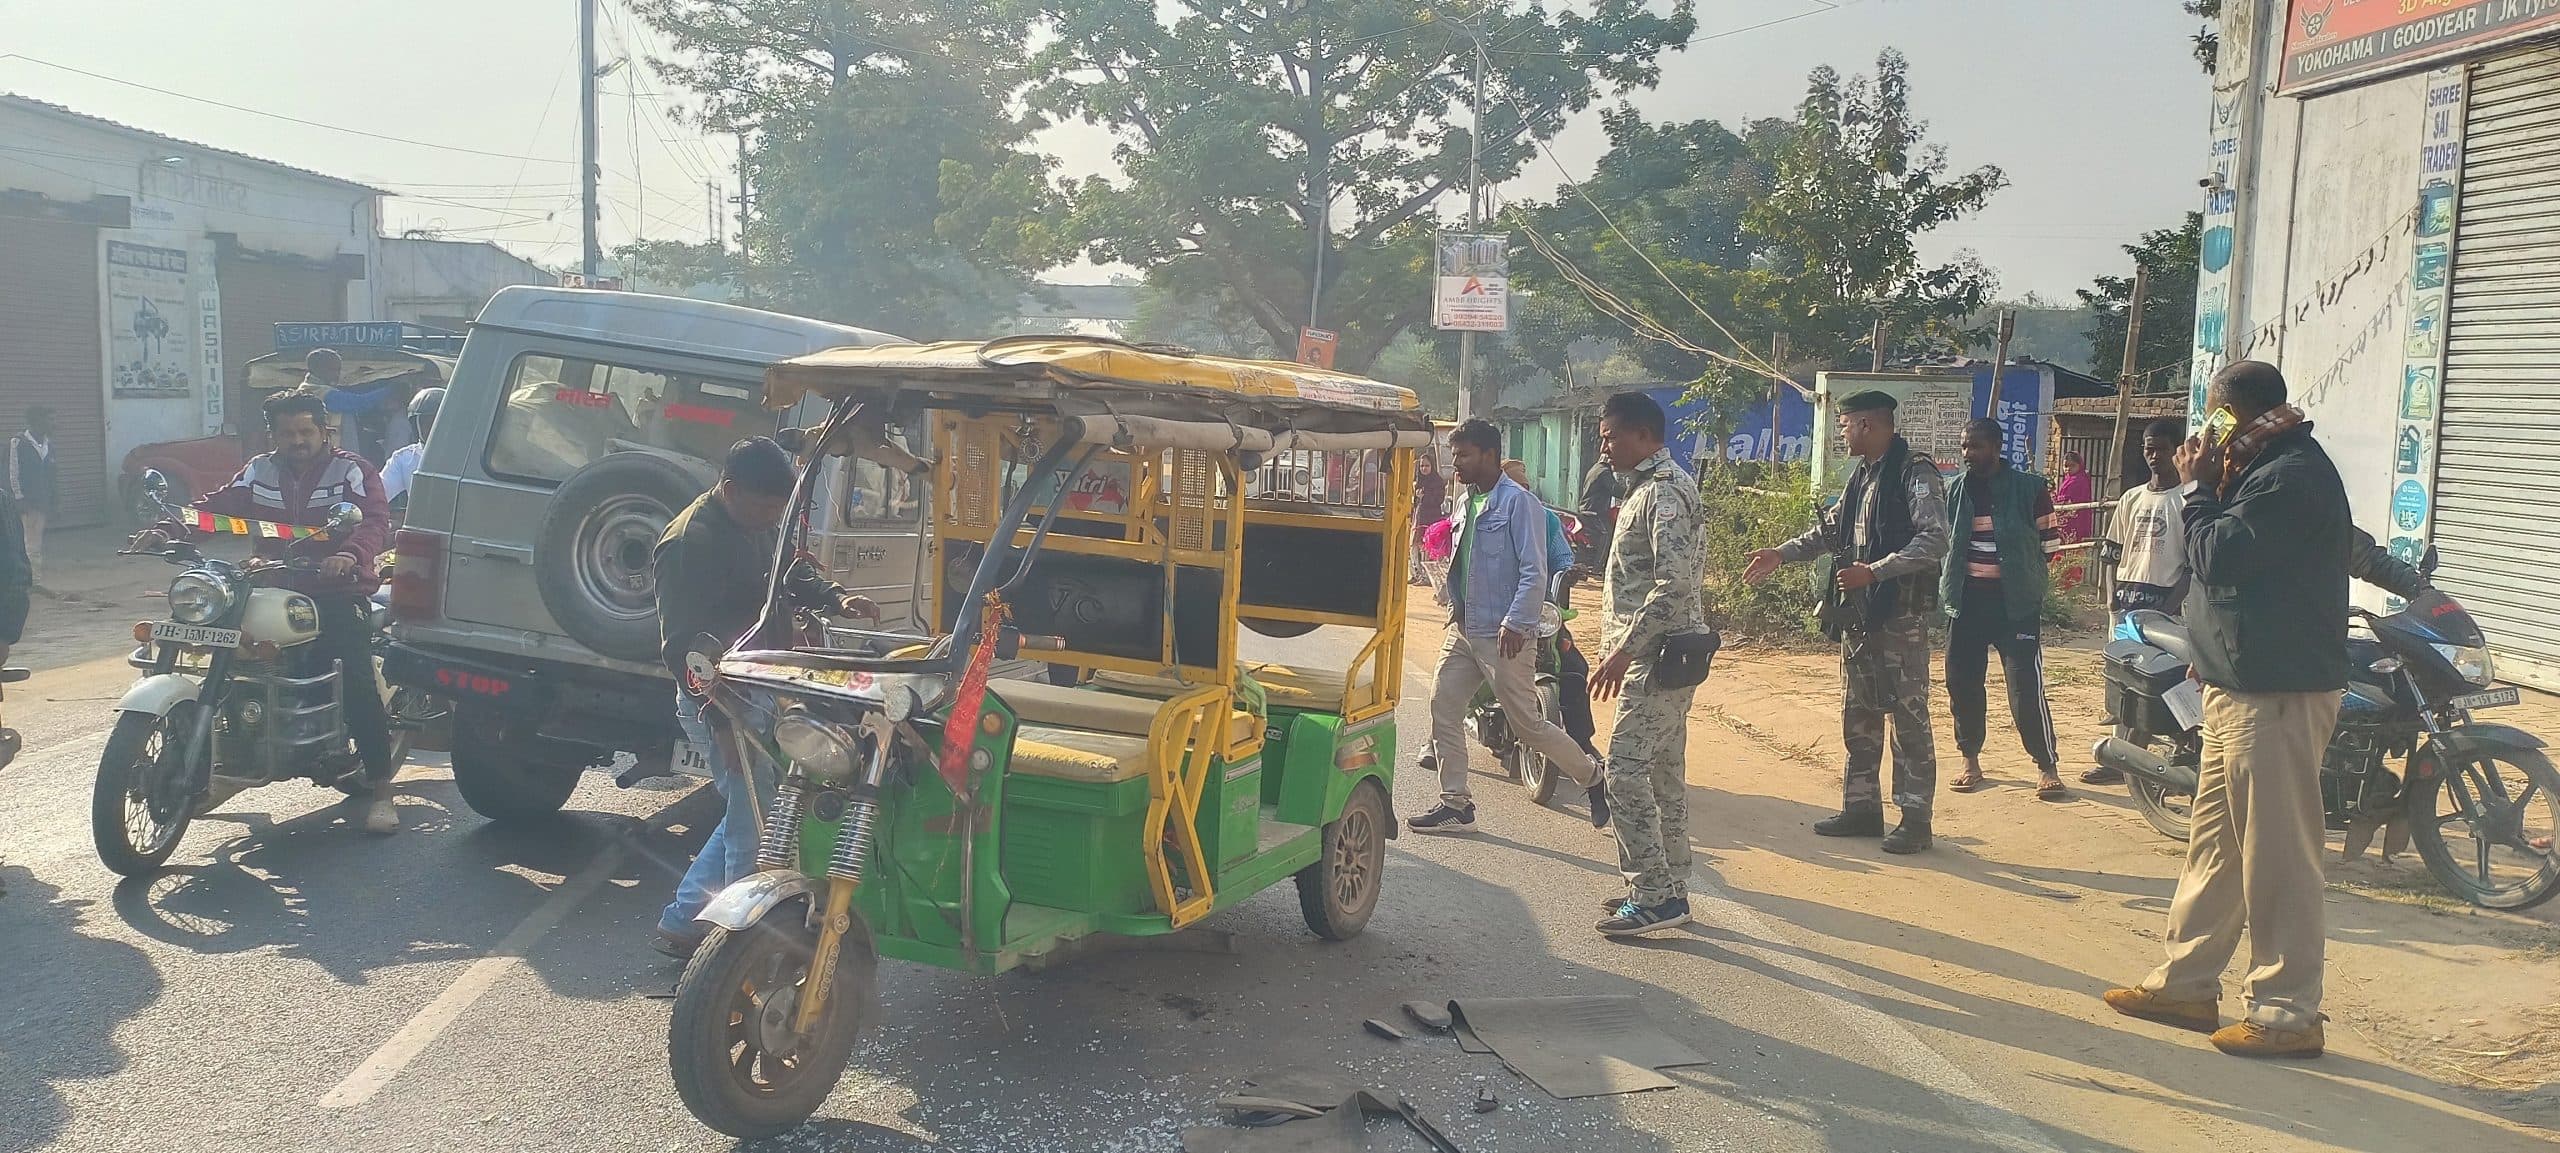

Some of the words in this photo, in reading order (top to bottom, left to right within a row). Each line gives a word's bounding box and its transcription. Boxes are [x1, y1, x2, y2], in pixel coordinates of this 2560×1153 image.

[2297, 36, 2373, 74] YOKOHAMA
[2393, 8, 2476, 50] GOODYEAR
[2428, 83, 2462, 108] SHREE
[2433, 110, 2450, 139] SAI
[2422, 142, 2458, 174] TRADER
[435, 667, 510, 695] STOP
